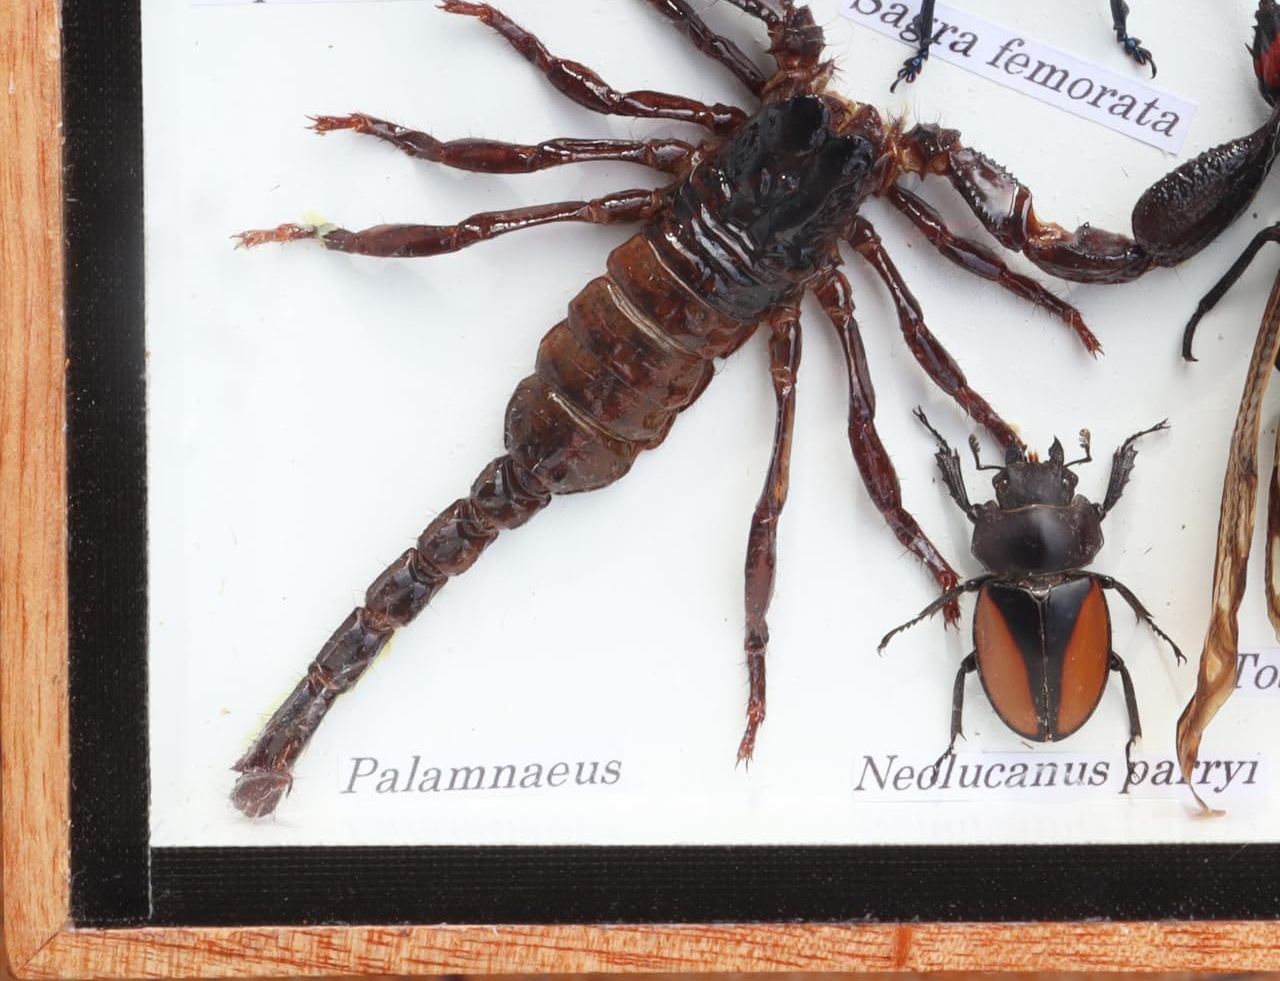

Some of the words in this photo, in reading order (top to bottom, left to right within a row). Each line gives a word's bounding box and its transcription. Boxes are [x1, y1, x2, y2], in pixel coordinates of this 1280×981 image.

[985, 37, 1181, 138] femorata
[340, 755, 623, 795] Palamnaeus
[853, 753, 1110, 792] Neolucanus
